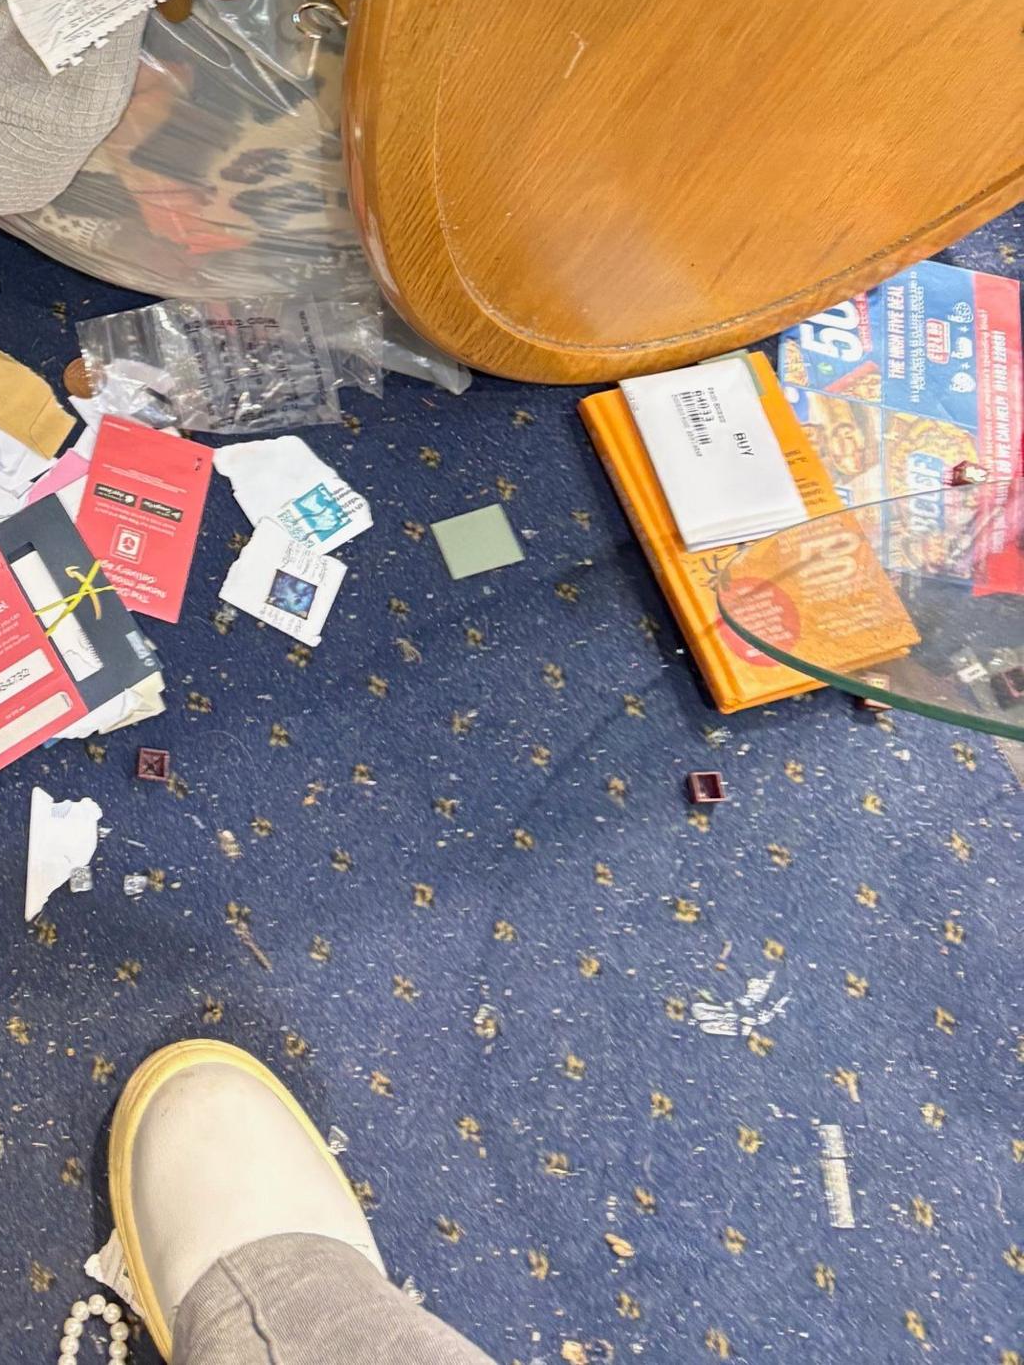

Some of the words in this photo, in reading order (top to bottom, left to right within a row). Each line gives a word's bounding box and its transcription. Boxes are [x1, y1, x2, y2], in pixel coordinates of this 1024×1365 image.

[886, 284, 905, 310] DEAL
[886, 310, 905, 333] FIVE
[886, 333, 906, 358] HIGH
[886, 359, 905, 379] THE
[733, 431, 754, 456] BUY
[113, 563, 157, 584] delivery
